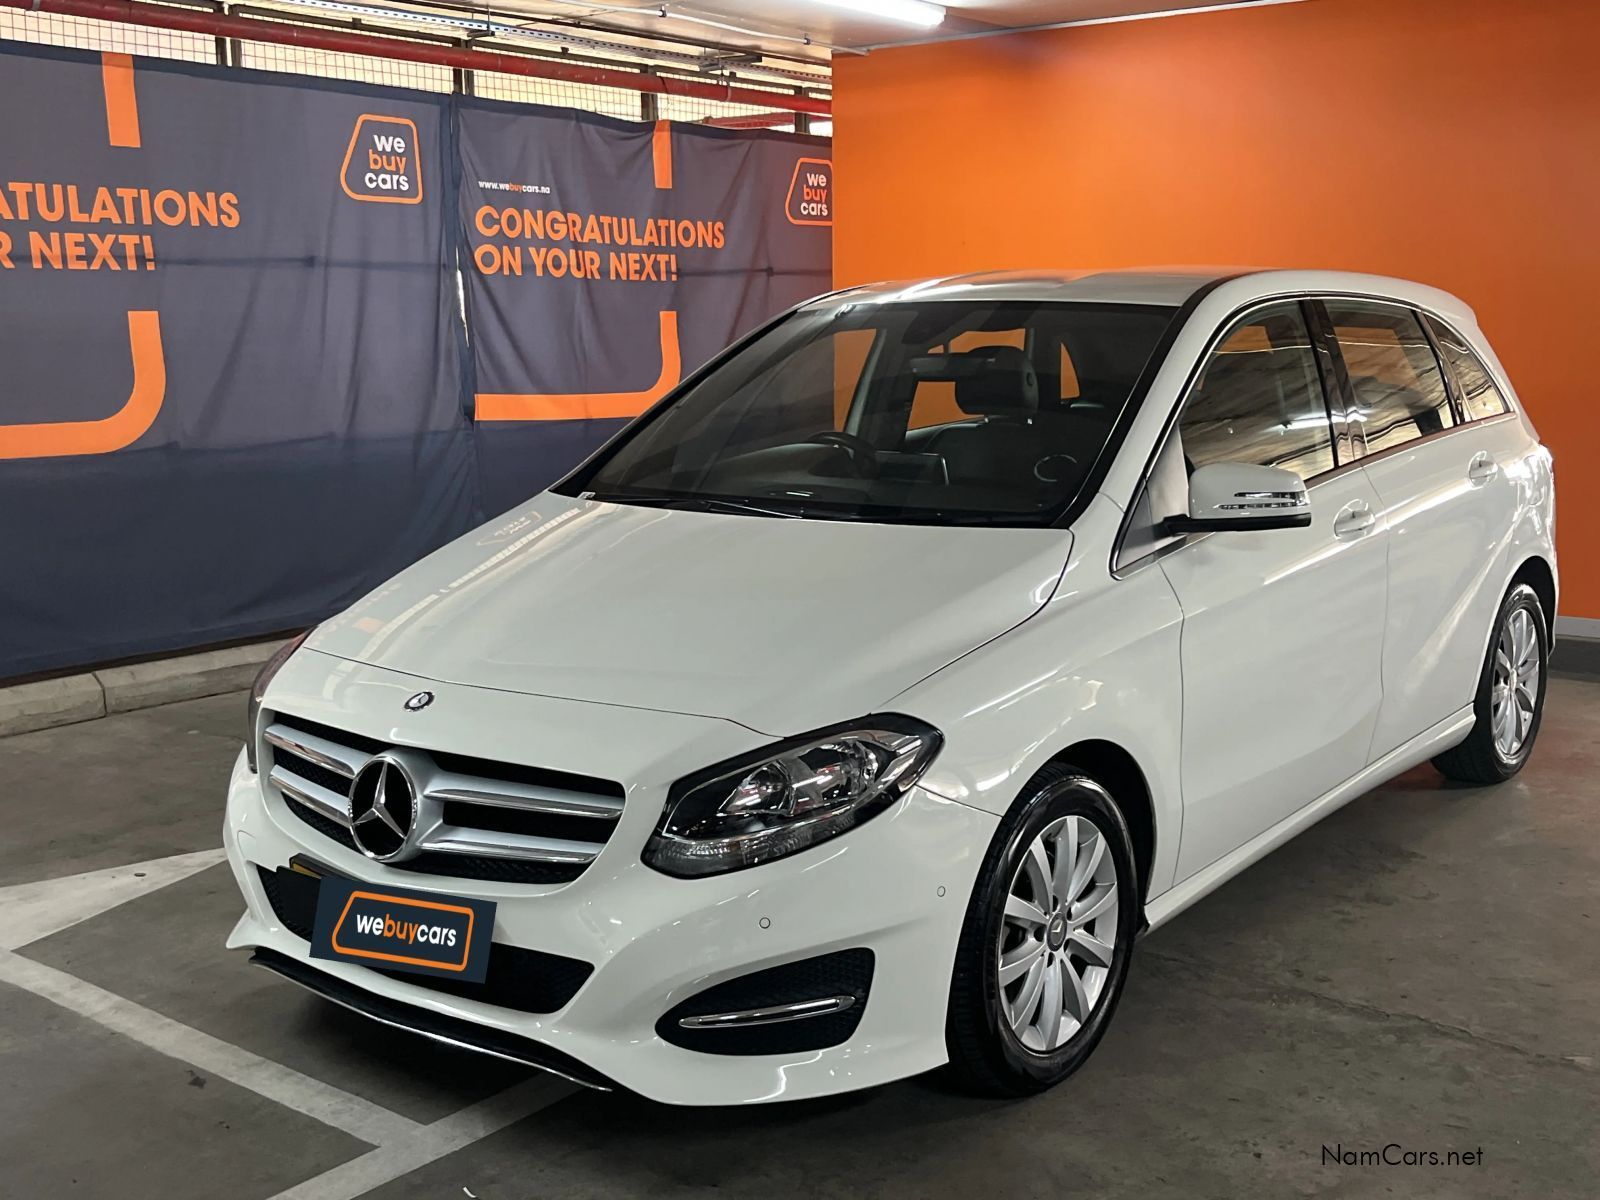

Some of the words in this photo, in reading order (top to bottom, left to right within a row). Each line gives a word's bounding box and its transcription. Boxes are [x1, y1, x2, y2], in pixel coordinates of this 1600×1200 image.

[373, 135, 405, 153] we
[369, 149, 406, 175] buy
[365, 172, 409, 191] cars
[478, 181, 551, 194] www.webuycars.na
[806, 173, 827, 187] we
[803, 184, 827, 204] buy
[800, 202, 828, 216] cars
[475, 205, 725, 249] CONGRATULATIONS
[29, 231, 156, 271] NEXT!
[474, 243, 522, 276] ON
[529, 247, 600, 280] YOUR
[609, 252, 677, 282] NEXT!
[356, 913, 457, 947] webuycars
